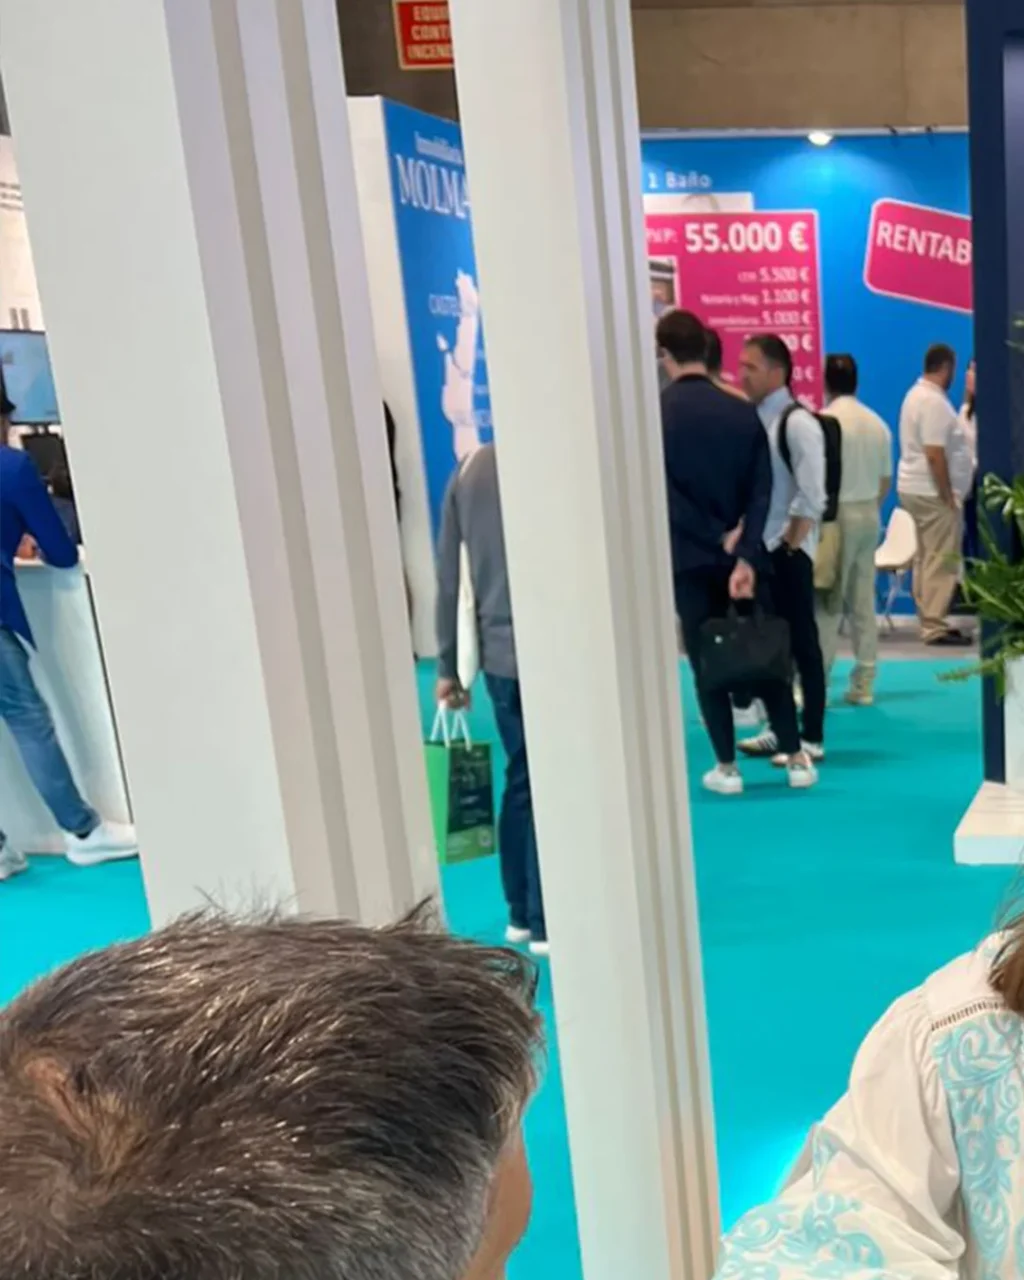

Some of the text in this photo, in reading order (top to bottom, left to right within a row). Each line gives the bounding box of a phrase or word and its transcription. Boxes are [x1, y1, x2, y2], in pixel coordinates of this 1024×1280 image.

[648, 171, 712, 189] 1 Baño
[685, 222, 782, 253] 55.000
[788, 222, 809, 253] €
